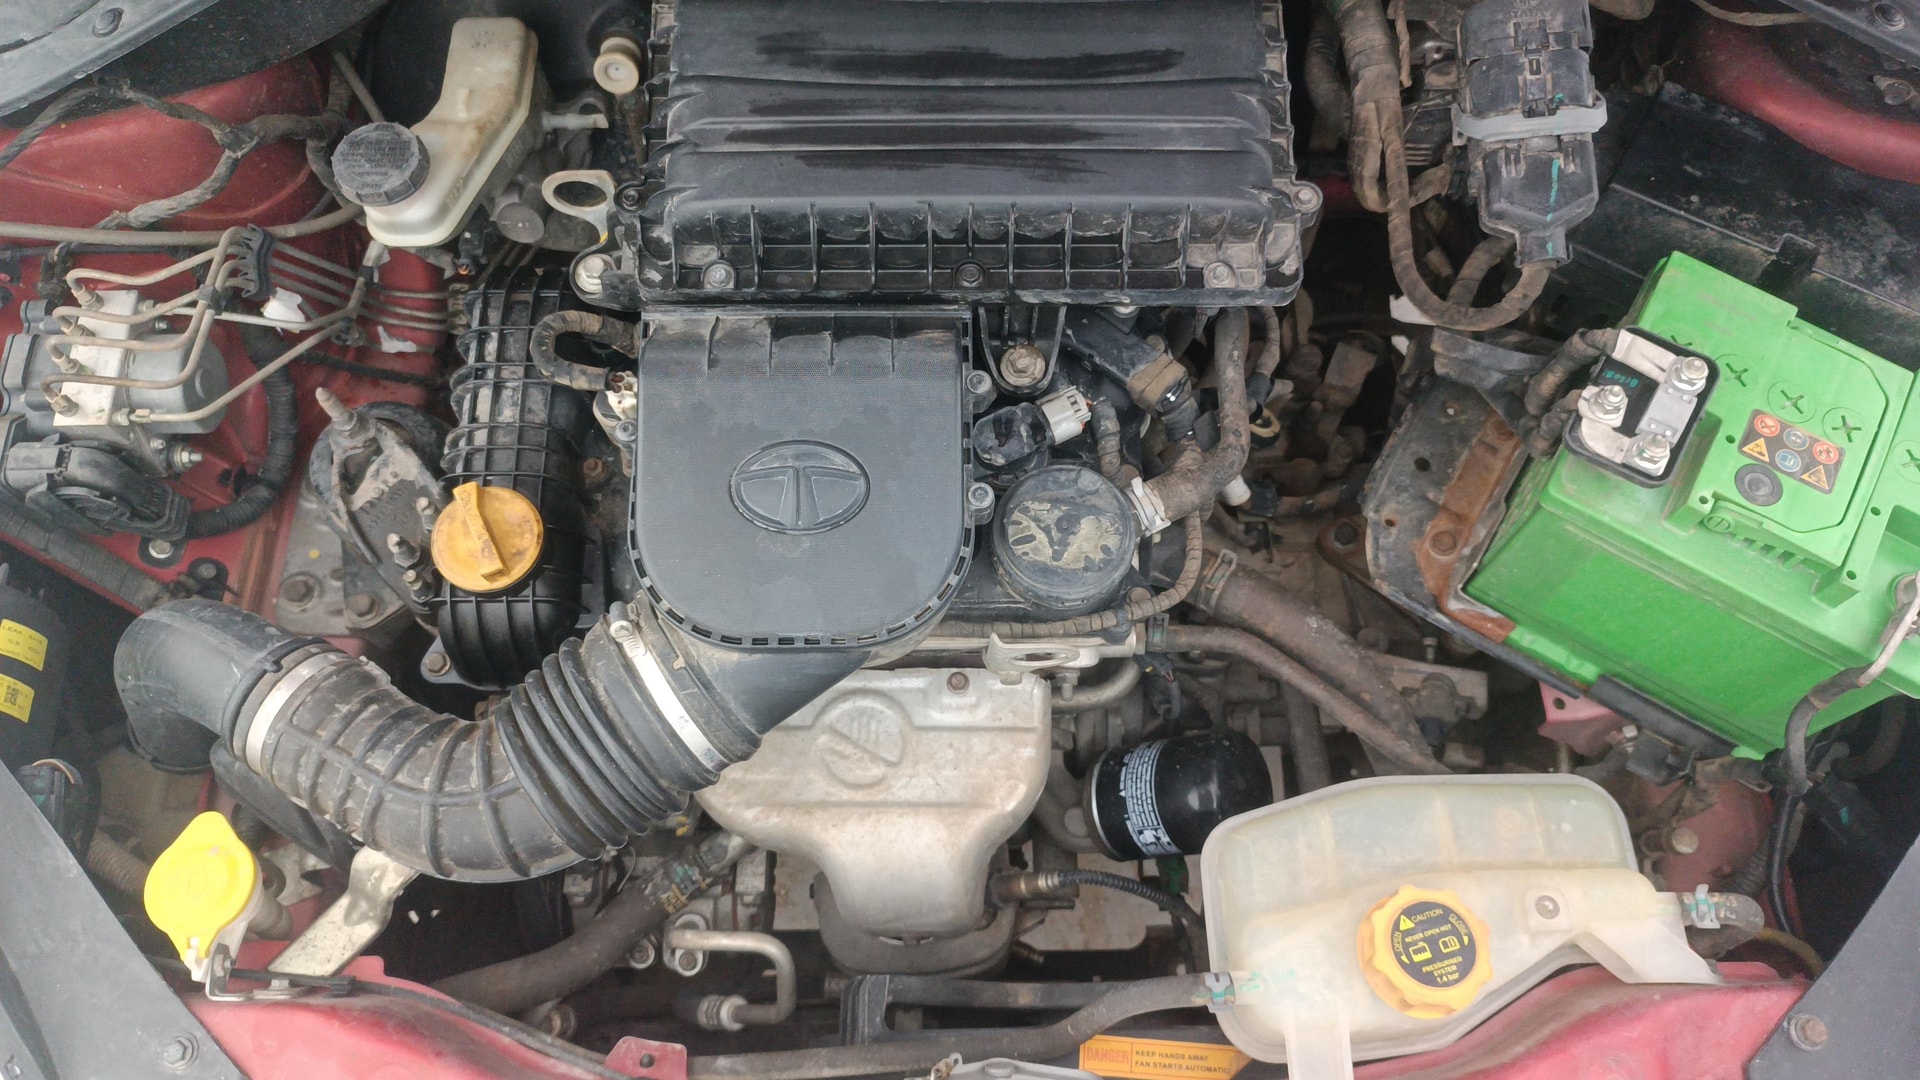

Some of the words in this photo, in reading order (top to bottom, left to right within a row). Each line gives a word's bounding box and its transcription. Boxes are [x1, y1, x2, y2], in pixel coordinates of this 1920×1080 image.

[1411, 907, 1444, 923] CAUTION
[1449, 913, 1468, 935] CLOSE
[1393, 930, 1401, 952] OPEN
[1405, 932, 1424, 943] NEVER
[1424, 927, 1440, 937] OPEN
[1440, 923, 1452, 932] HOT
[1433, 964, 1457, 977] SYSTEM
[1437, 974, 1448, 984] 1.4
[1447, 972, 1459, 981] bar
[1086, 1047, 1129, 1065] DANGER
[1135, 1049, 1156, 1058] KEEP
[1158, 1051, 1185, 1060] HANDS
[1187, 1054, 1208, 1062] AWAY
[1135, 1060, 1150, 1068] FAN
[1153, 1061, 1183, 1071] STARTS
